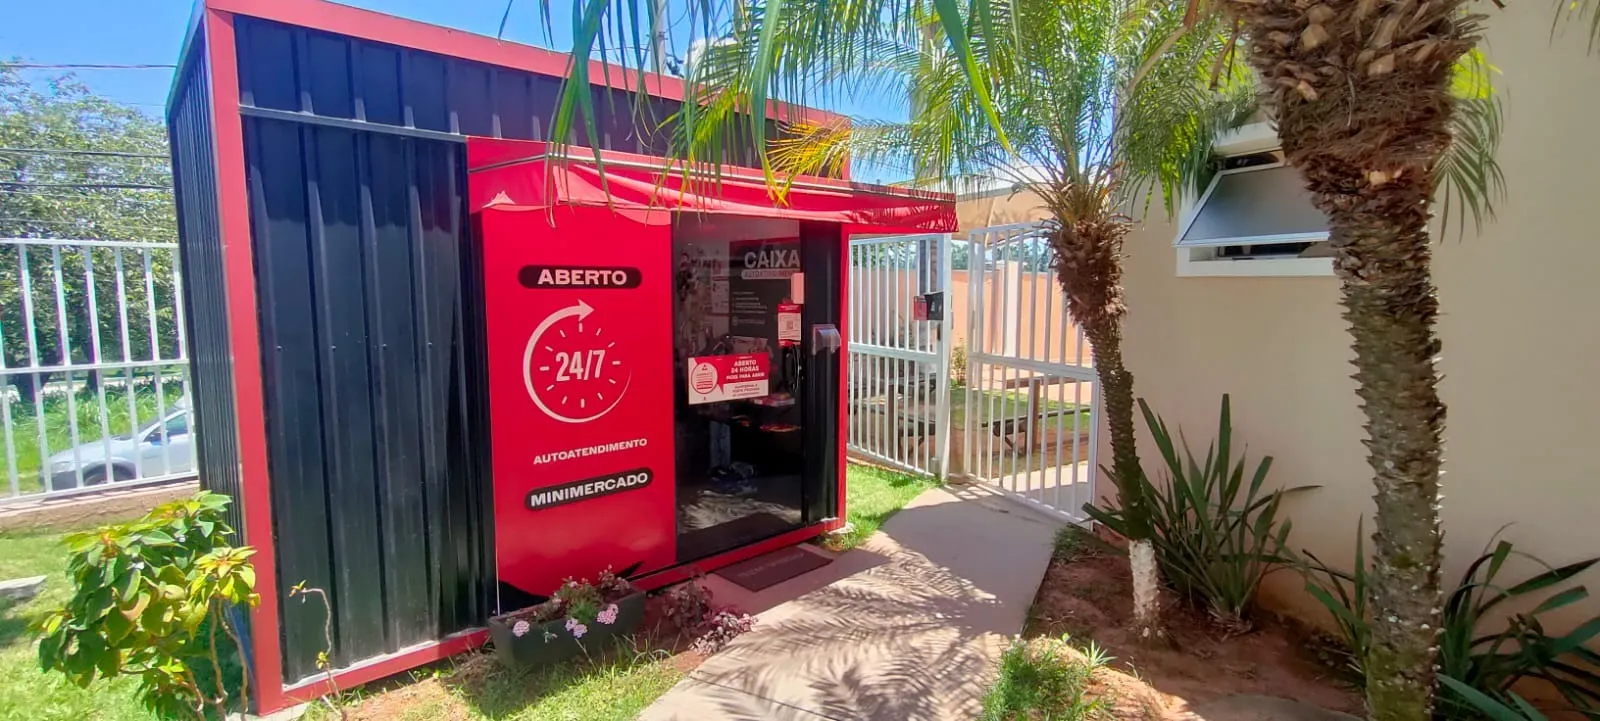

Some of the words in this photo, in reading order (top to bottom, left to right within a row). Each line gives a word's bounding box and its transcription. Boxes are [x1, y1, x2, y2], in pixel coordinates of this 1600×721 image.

[744, 250, 800, 268] CAIXA
[537, 269, 628, 285] ABERTO
[555, 350, 606, 382] 24/7
[533, 438, 648, 465] AUTOATENDIMENTO
[530, 472, 648, 507] MINIMERCADO
